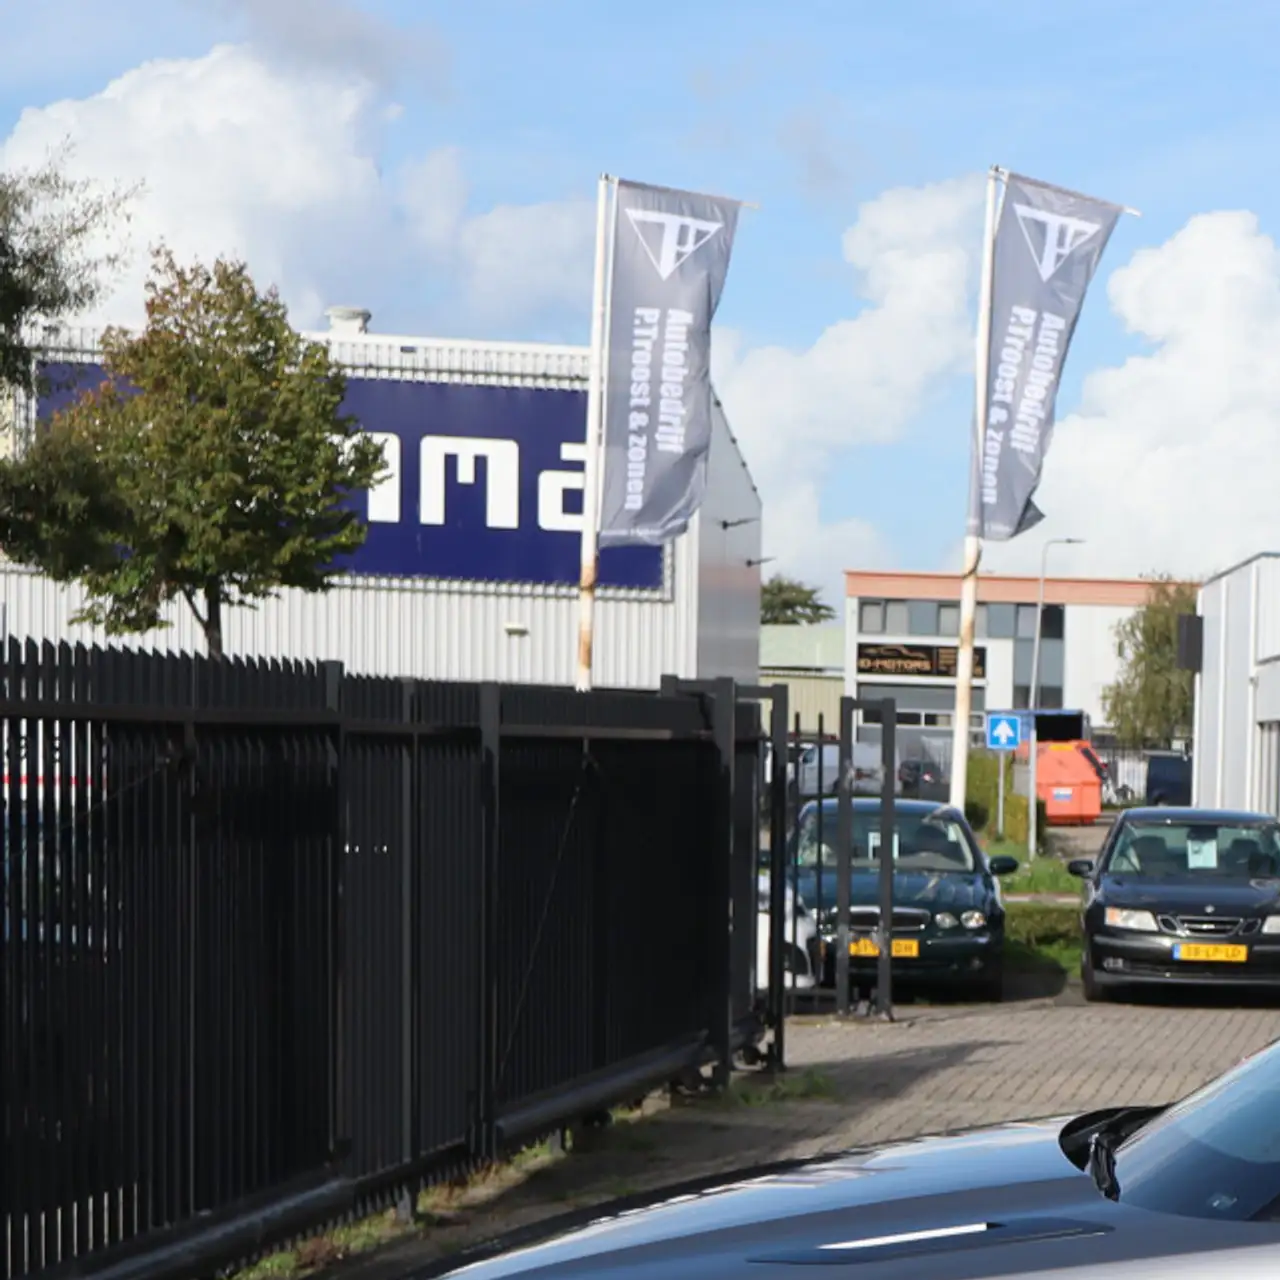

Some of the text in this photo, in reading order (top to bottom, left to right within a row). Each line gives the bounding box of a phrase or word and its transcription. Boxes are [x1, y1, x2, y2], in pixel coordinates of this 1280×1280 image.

[655, 308, 694, 454] Autobedrijf
[989, 405, 1009, 425] &
[1009, 311, 1066, 454] Autobedrijf
[628, 411, 650, 431] &
[624, 433, 648, 510] zonen
